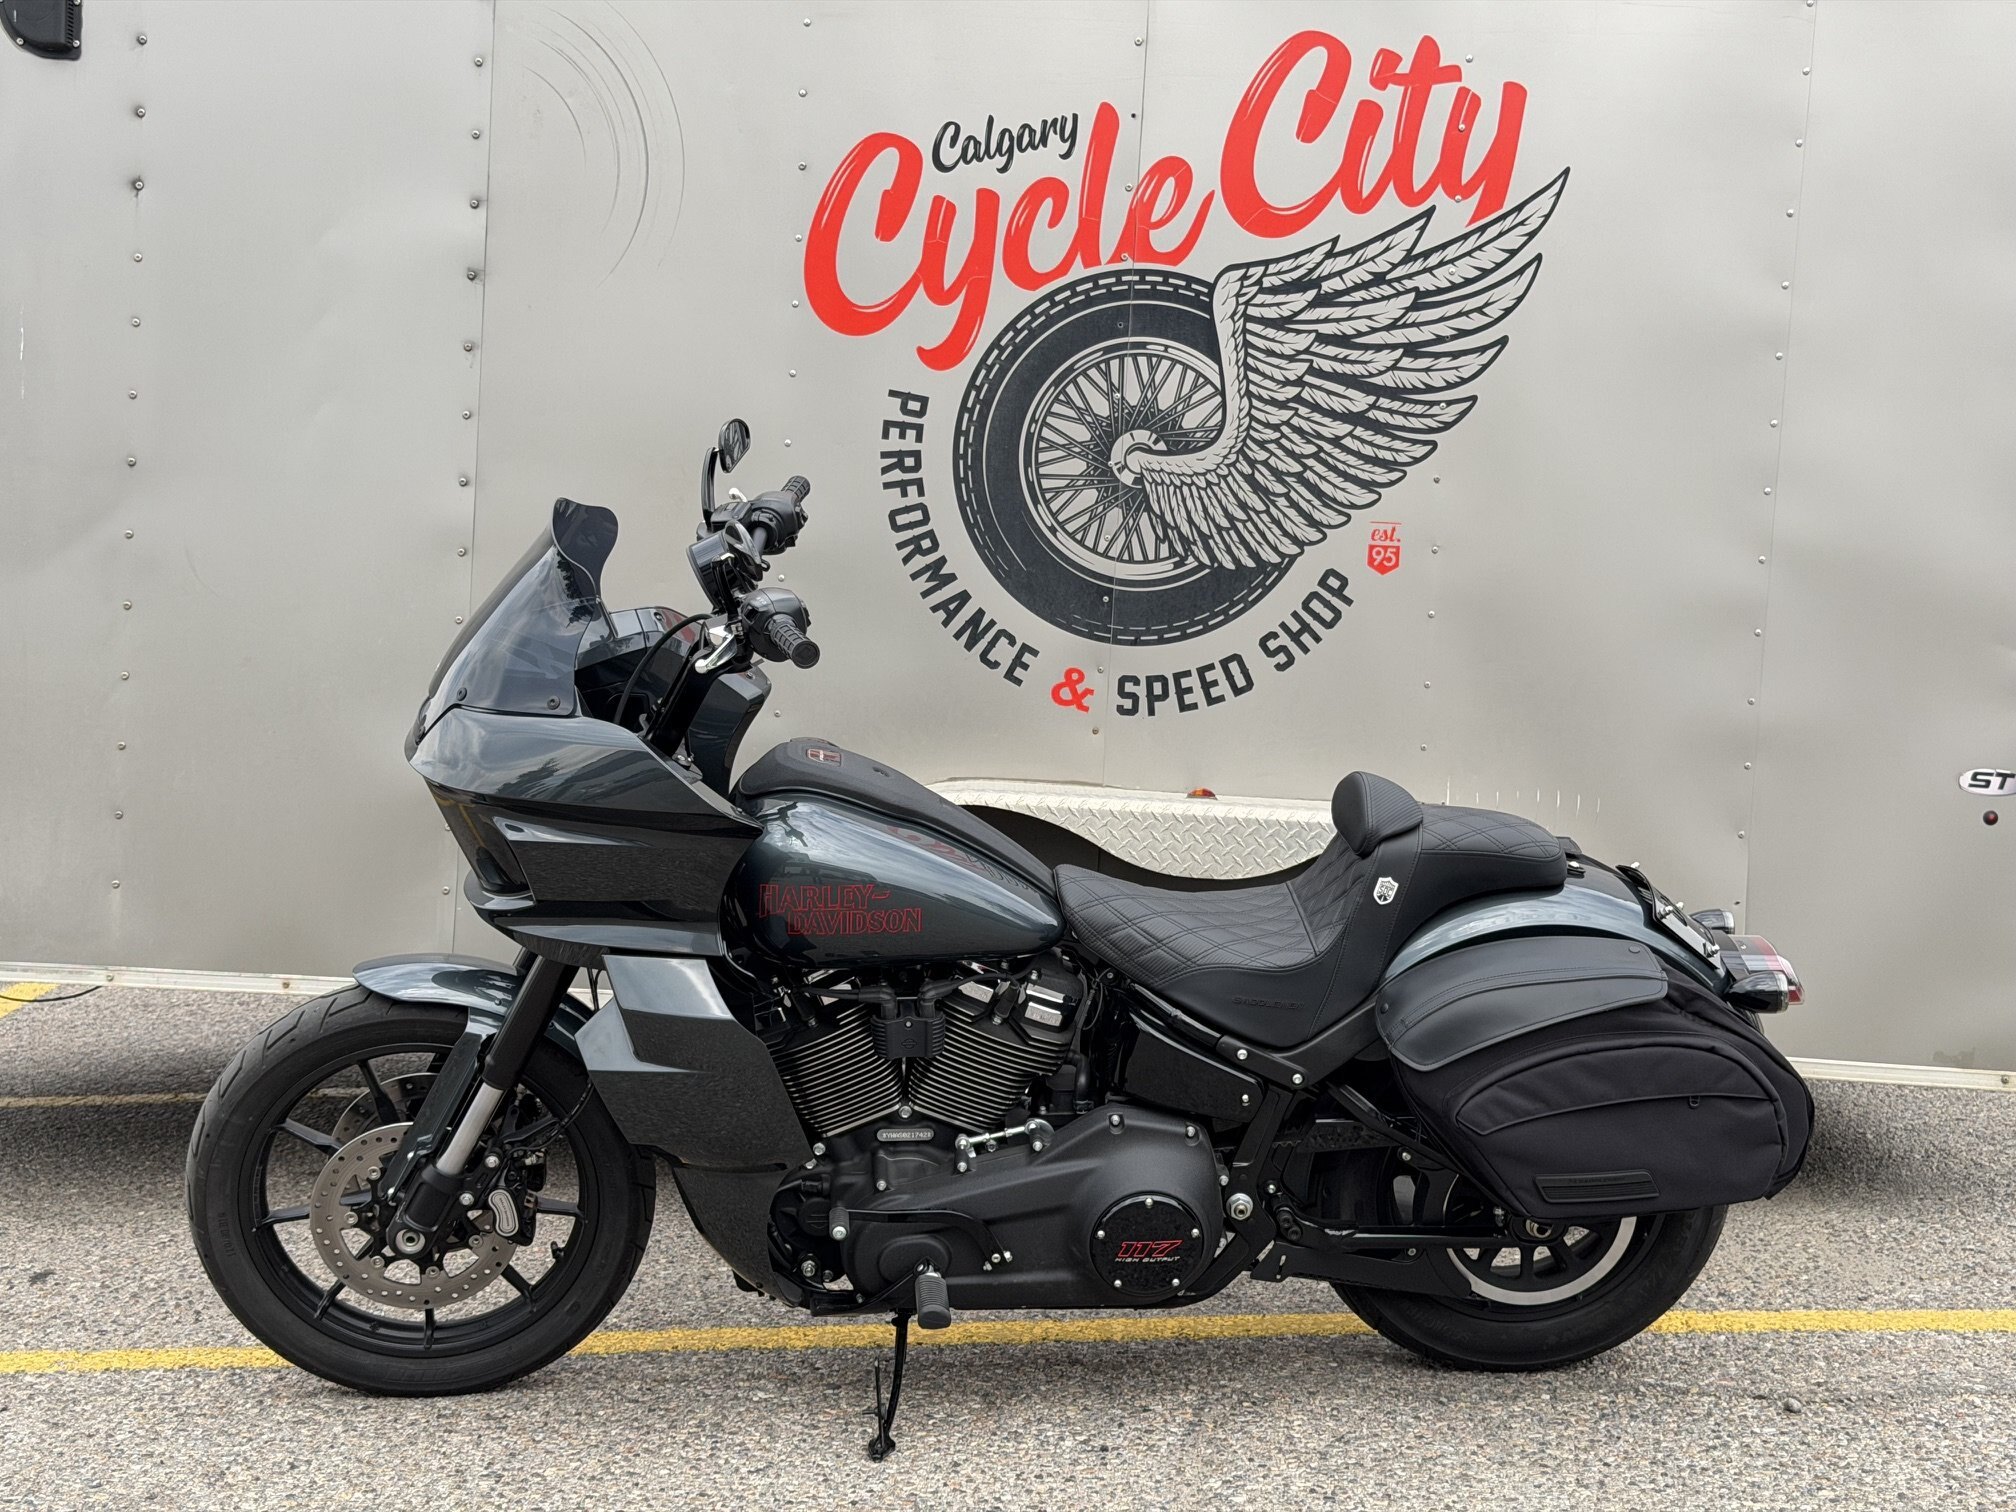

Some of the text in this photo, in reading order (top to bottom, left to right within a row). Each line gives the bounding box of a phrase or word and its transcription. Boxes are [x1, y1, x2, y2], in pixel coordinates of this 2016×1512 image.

[932, 112, 1079, 174] Calgary
[803, 30, 1529, 371] Cycle City
[1371, 526, 1401, 543] est.
[880, 389, 1354, 717] PERFORMANCE & SPEED SHOP
[1371, 546, 1397, 567] 95
[759, 883, 892, 918] HARLEY-
[786, 907, 924, 937] DAVIDSON
[1117, 1239, 1184, 1258] 117
